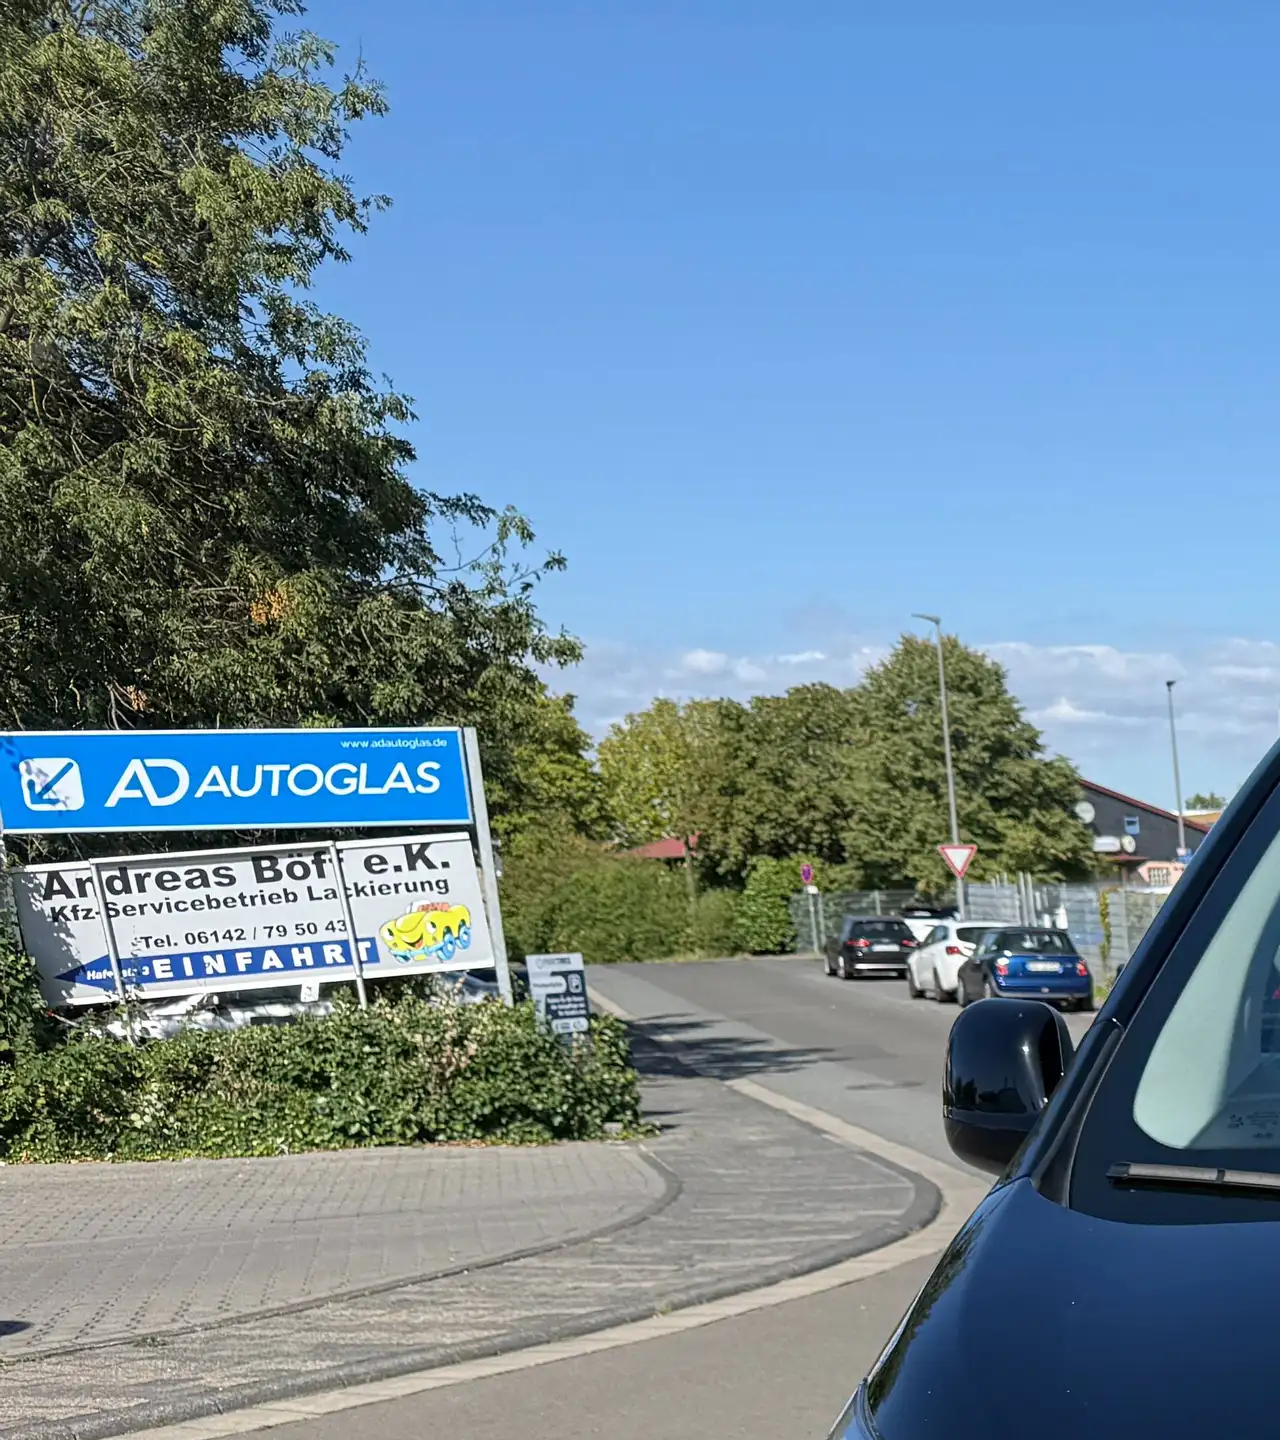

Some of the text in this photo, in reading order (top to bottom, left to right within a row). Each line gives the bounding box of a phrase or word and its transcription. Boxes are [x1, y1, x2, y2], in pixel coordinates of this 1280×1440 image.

[340, 737, 447, 750] www.adautoglas.de
[104, 758, 441, 808] AD AUTOGLAS
[251, 850, 344, 884] Böf
[363, 842, 450, 875] e.K.
[140, 935, 178, 950] Tel.
[184, 928, 247, 946] 06142
[263, 924, 287, 939] 79
[294, 922, 318, 936] 50
[325, 919, 347, 933] 43
[152, 941, 372, 979] EINFAHRT
